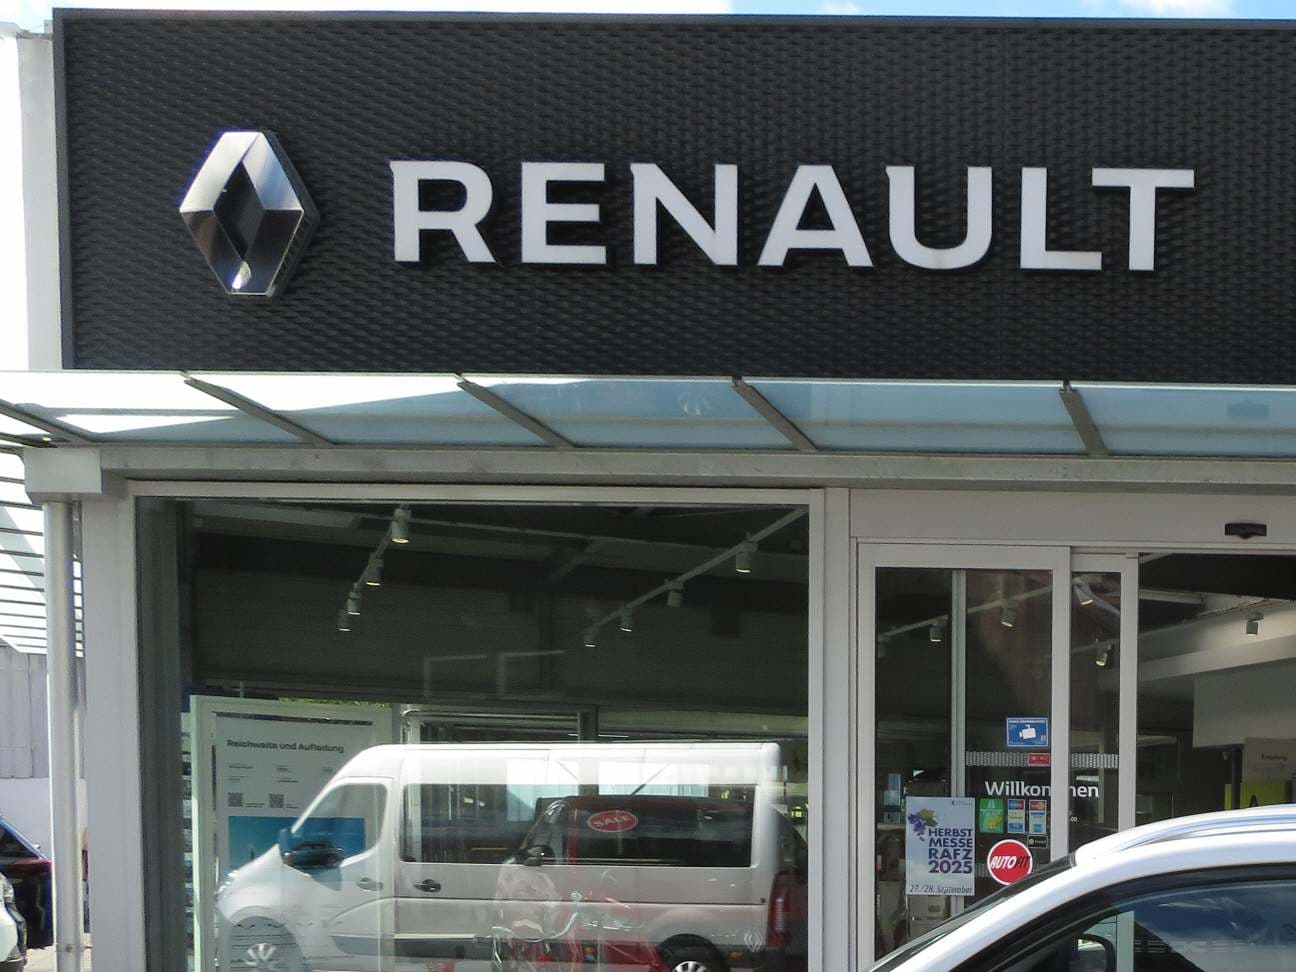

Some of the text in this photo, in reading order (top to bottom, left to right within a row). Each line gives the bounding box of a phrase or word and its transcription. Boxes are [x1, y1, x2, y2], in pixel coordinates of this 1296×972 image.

[390, 160, 1195, 271] RENAULT
[226, 739, 344, 754] Reichweite und Aufladung
[928, 828, 973, 837] HERBST
[928, 837, 974, 848] MESSE
[928, 848, 973, 860] RAFZ
[928, 860, 973, 874] 2025
